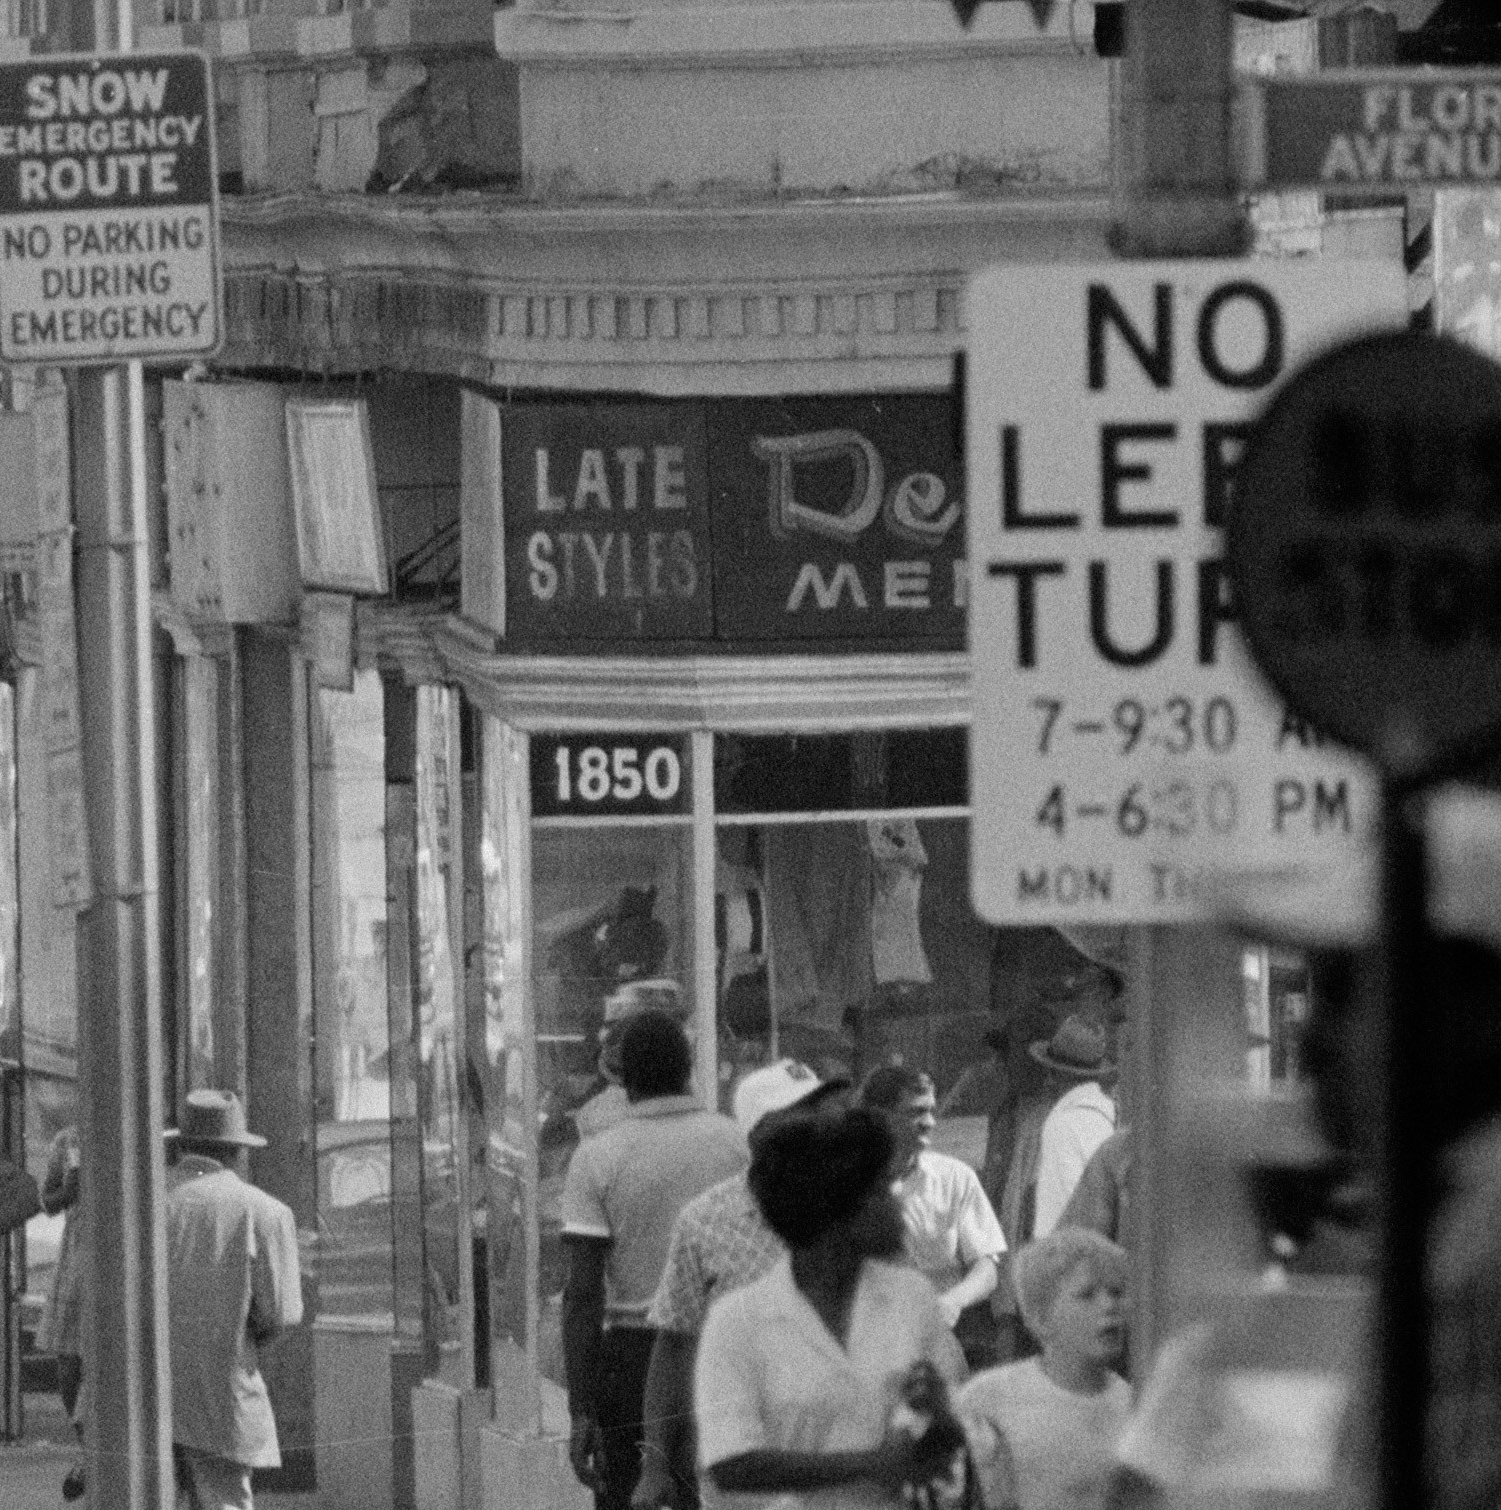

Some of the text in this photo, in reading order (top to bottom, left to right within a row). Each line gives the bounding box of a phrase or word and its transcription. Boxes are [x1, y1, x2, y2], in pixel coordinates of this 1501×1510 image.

[26, 67, 170, 120] SNOW
[1363, 84, 1501, 132] FLOR
[20, 152, 179, 200] ROUTE
[1319, 132, 1501, 180] AVENU
[3, 216, 205, 260] NO PARKING
[42, 259, 172, 300] DURING
[10, 300, 208, 346] EMERGENCY
[1085, 276, 1284, 393] NO
[534, 445, 688, 513] LATE
[749, 428, 963, 546] De
[1002, 420, 1261, 530] LEF
[526, 528, 698, 602] STYLES
[987, 560, 1249, 669] TUR
[1032, 696, 1239, 756] 7-9:30
[555, 746, 681, 801] 1850
[1035, 777, 1352, 838] 4-6:30 PM
[1017, 867, 1113, 905] MON
